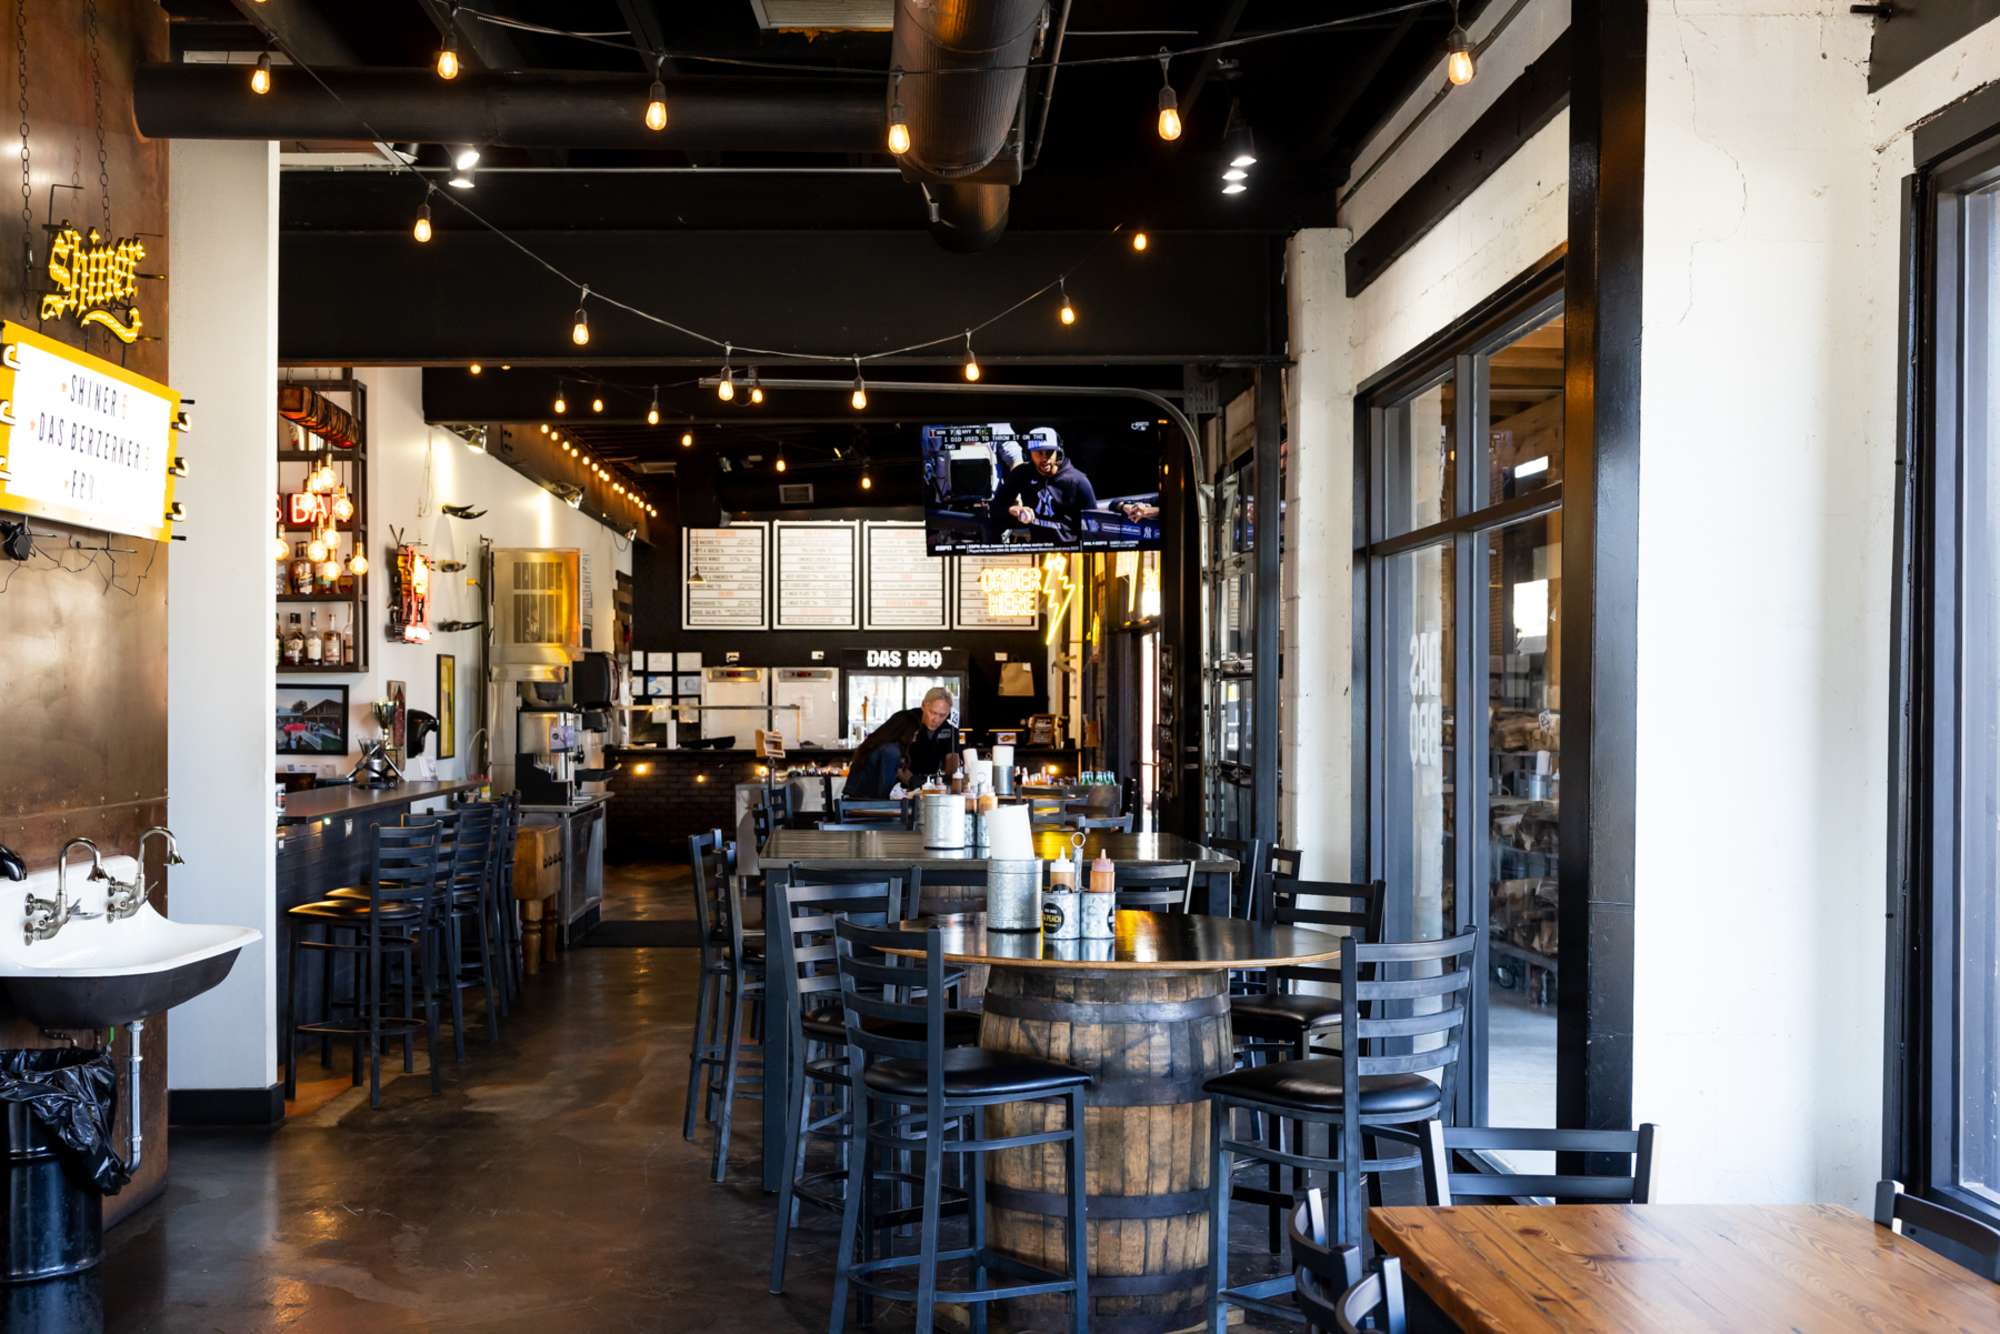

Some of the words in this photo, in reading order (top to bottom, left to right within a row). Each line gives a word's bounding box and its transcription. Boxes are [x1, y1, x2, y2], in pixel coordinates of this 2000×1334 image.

[70, 373, 117, 417] SHINER
[38, 411, 64, 446] DAS
[70, 421, 141, 471] BERZERKER
[980, 568, 1041, 593] ORDER
[989, 592, 1037, 617] HERE
[867, 650, 902, 668] DAS
[907, 650, 943, 670] BBQ
